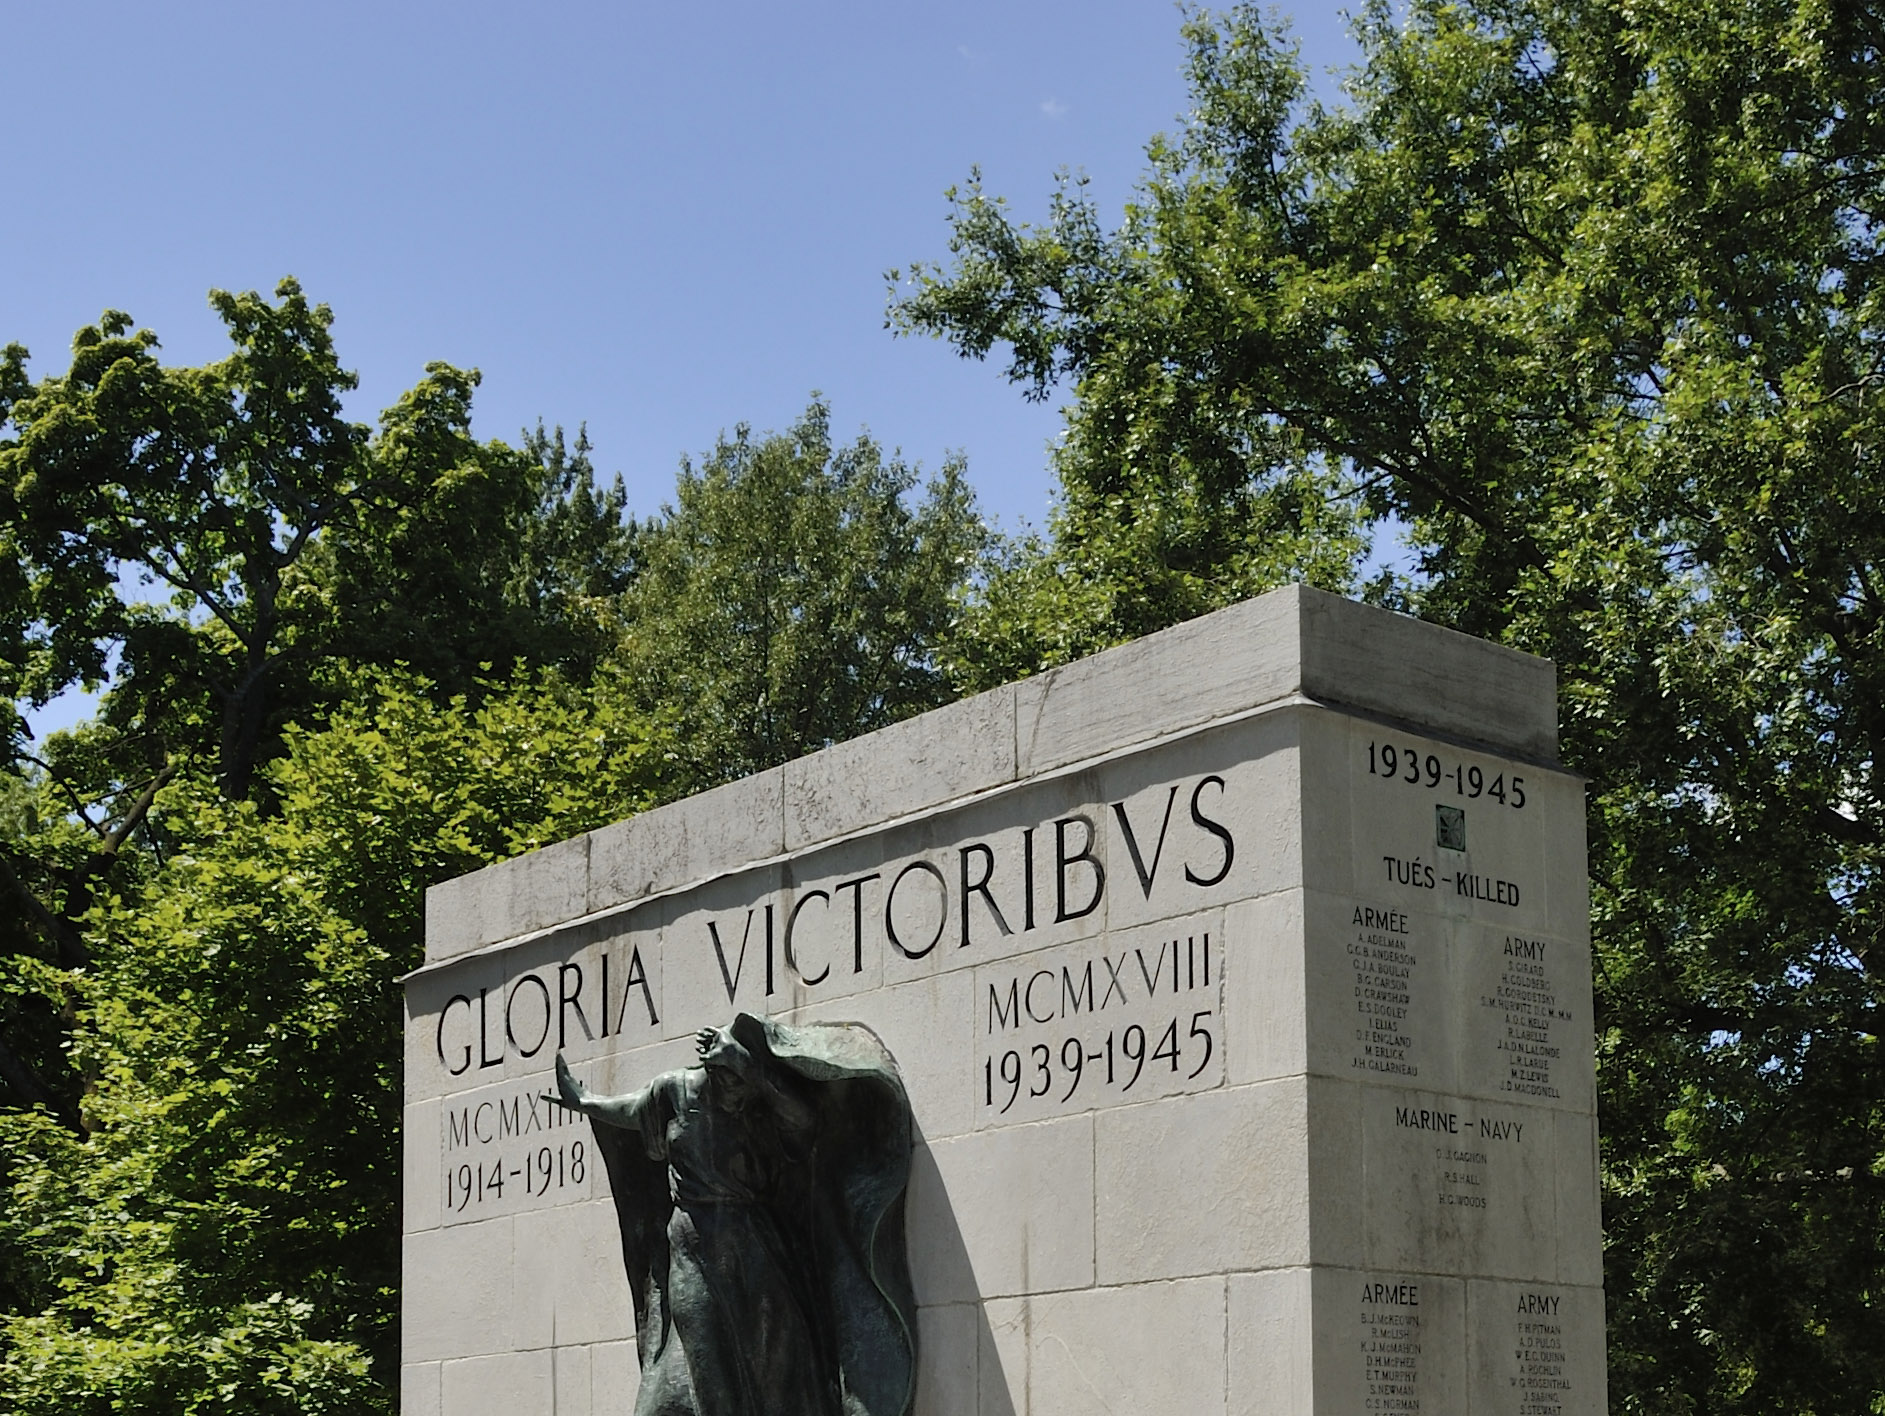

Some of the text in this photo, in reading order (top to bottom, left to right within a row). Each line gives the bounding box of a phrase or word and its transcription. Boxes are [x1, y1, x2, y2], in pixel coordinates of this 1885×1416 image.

[1368, 741, 1526, 809] 1939-1945
[1383, 856, 1435, 889] TUÉS
[1456, 872, 1520, 907] KILLED
[436, 775, 1235, 1076] GLORIA VICTORIBVS
[1352, 906, 1409, 934] ARMÉE
[1504, 936, 1546, 961] ARMY
[988, 933, 1209, 1035] MCMXVIII
[985, 1010, 1213, 1114] 1939-1945
[1396, 1106, 1458, 1134] MARINE
[1481, 1118, 1523, 1142] NAVY
[447, 1141, 585, 1213] 1914-1918
[1361, 1280, 1419, 1305] ARMÉE
[1517, 1293, 1560, 1315] ARMY
